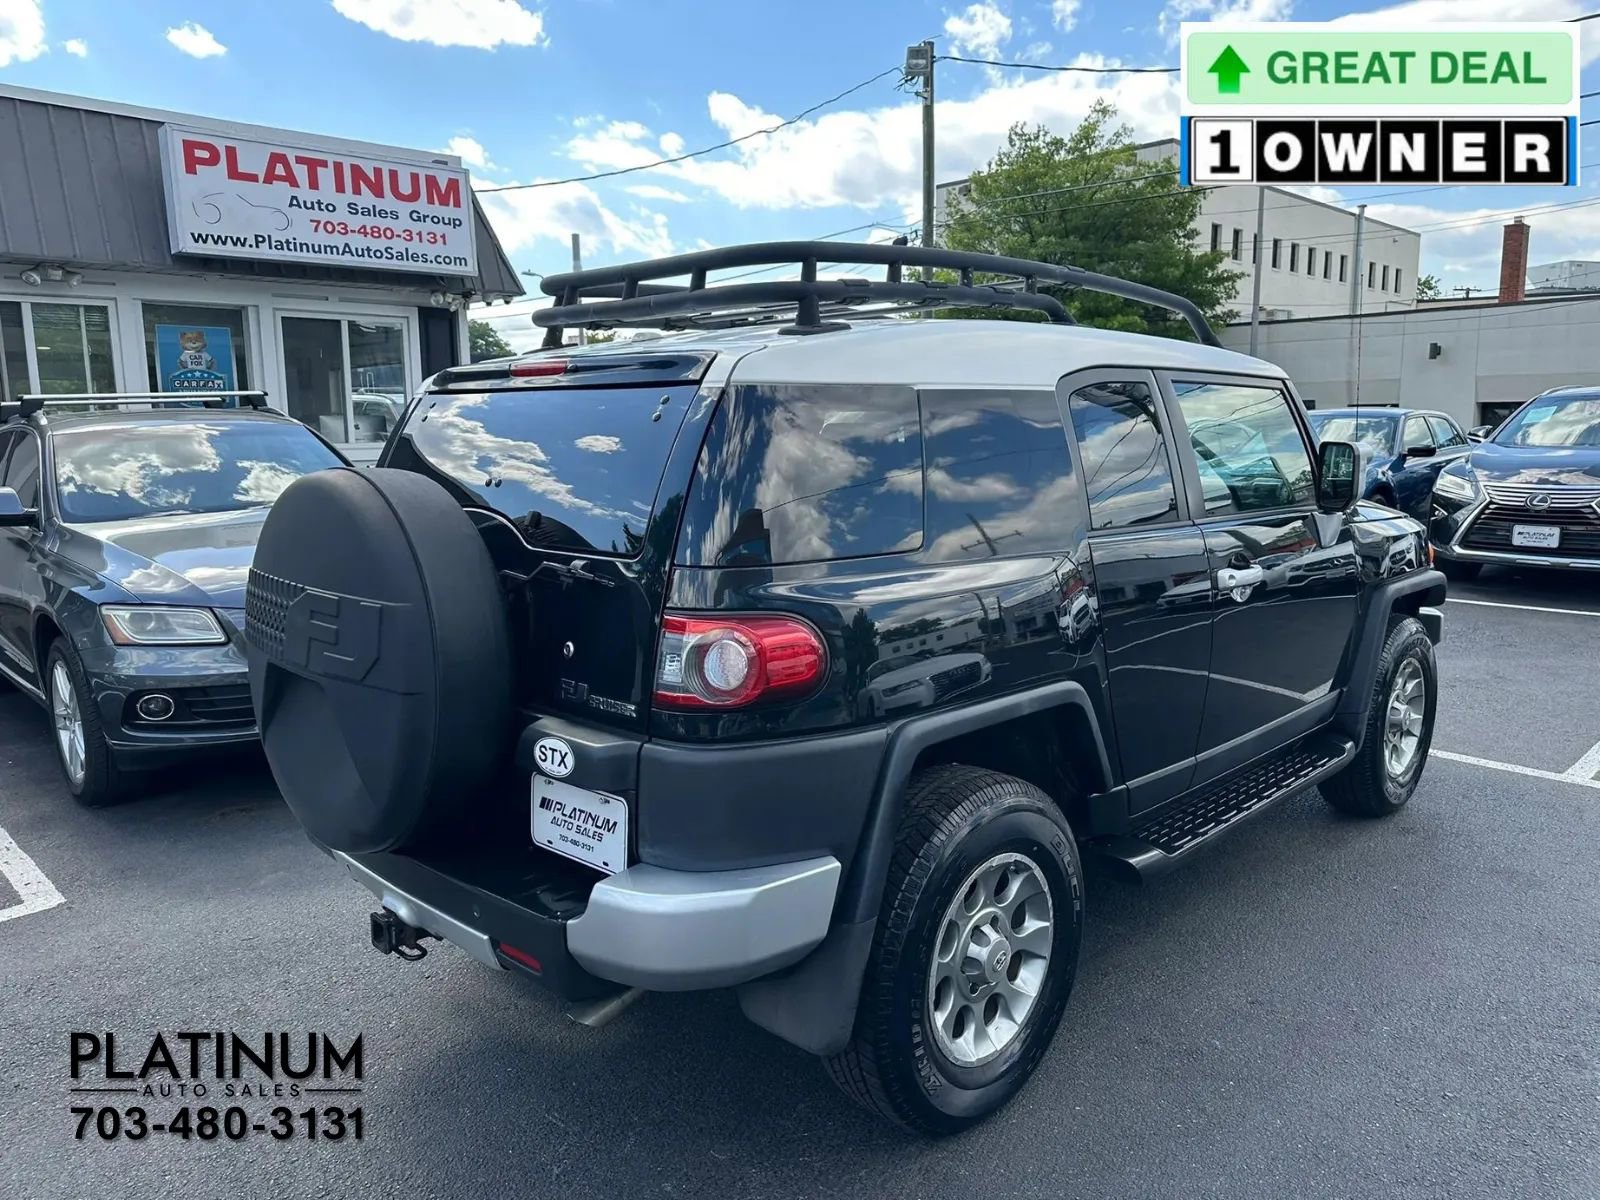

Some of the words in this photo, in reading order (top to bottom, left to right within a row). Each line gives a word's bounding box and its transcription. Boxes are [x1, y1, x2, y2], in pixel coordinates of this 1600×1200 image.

[181, 139, 462, 209] PLATINUM
[288, 195, 336, 214] Auto
[346, 202, 399, 221] Sales
[408, 210, 463, 229] Group
[309, 219, 447, 246] 703-480-3131
[190, 230, 468, 267] www.PlatinumAutoSales.com
[174, 380, 224, 389] CARFAX
[538, 744, 568, 770] STX
[550, 816, 574, 831] AUTO
[575, 824, 604, 843] SALES
[552, 801, 618, 834] PLATINUM
